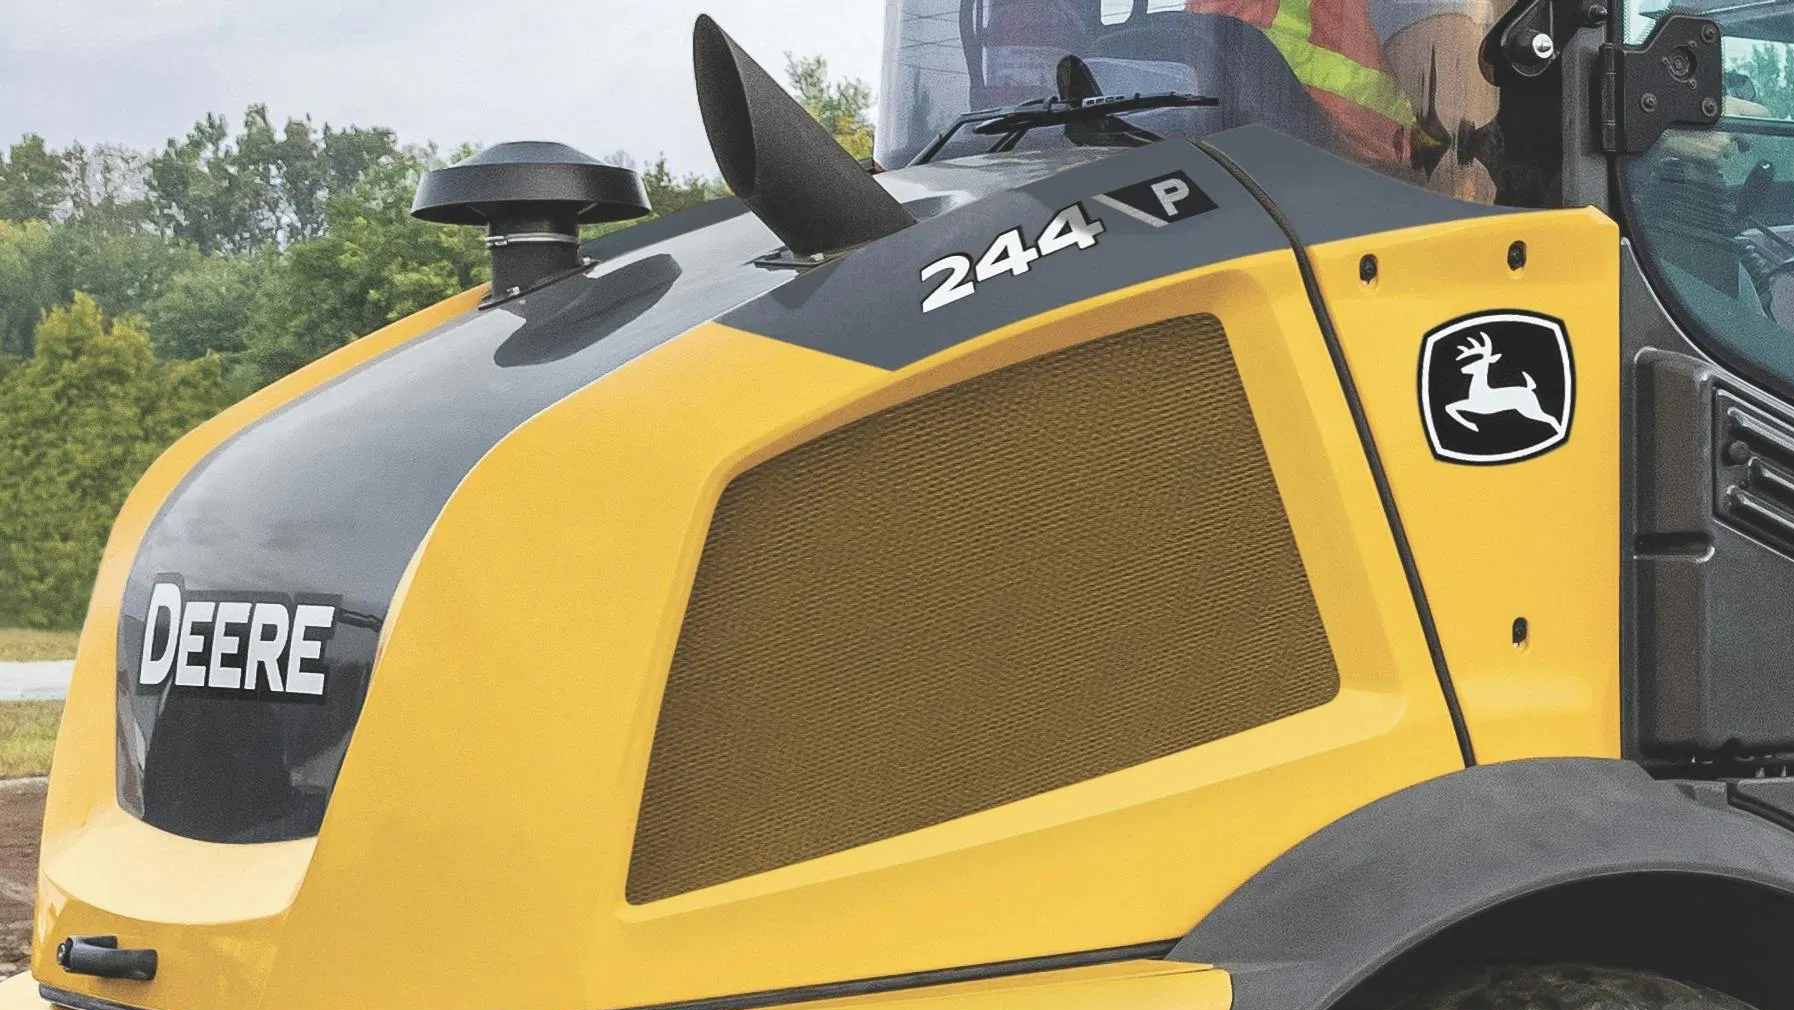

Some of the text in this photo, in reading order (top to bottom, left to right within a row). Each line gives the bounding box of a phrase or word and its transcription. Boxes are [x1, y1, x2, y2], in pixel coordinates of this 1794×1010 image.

[920, 178, 1190, 313] 244 P
[139, 583, 336, 696] DEERE
